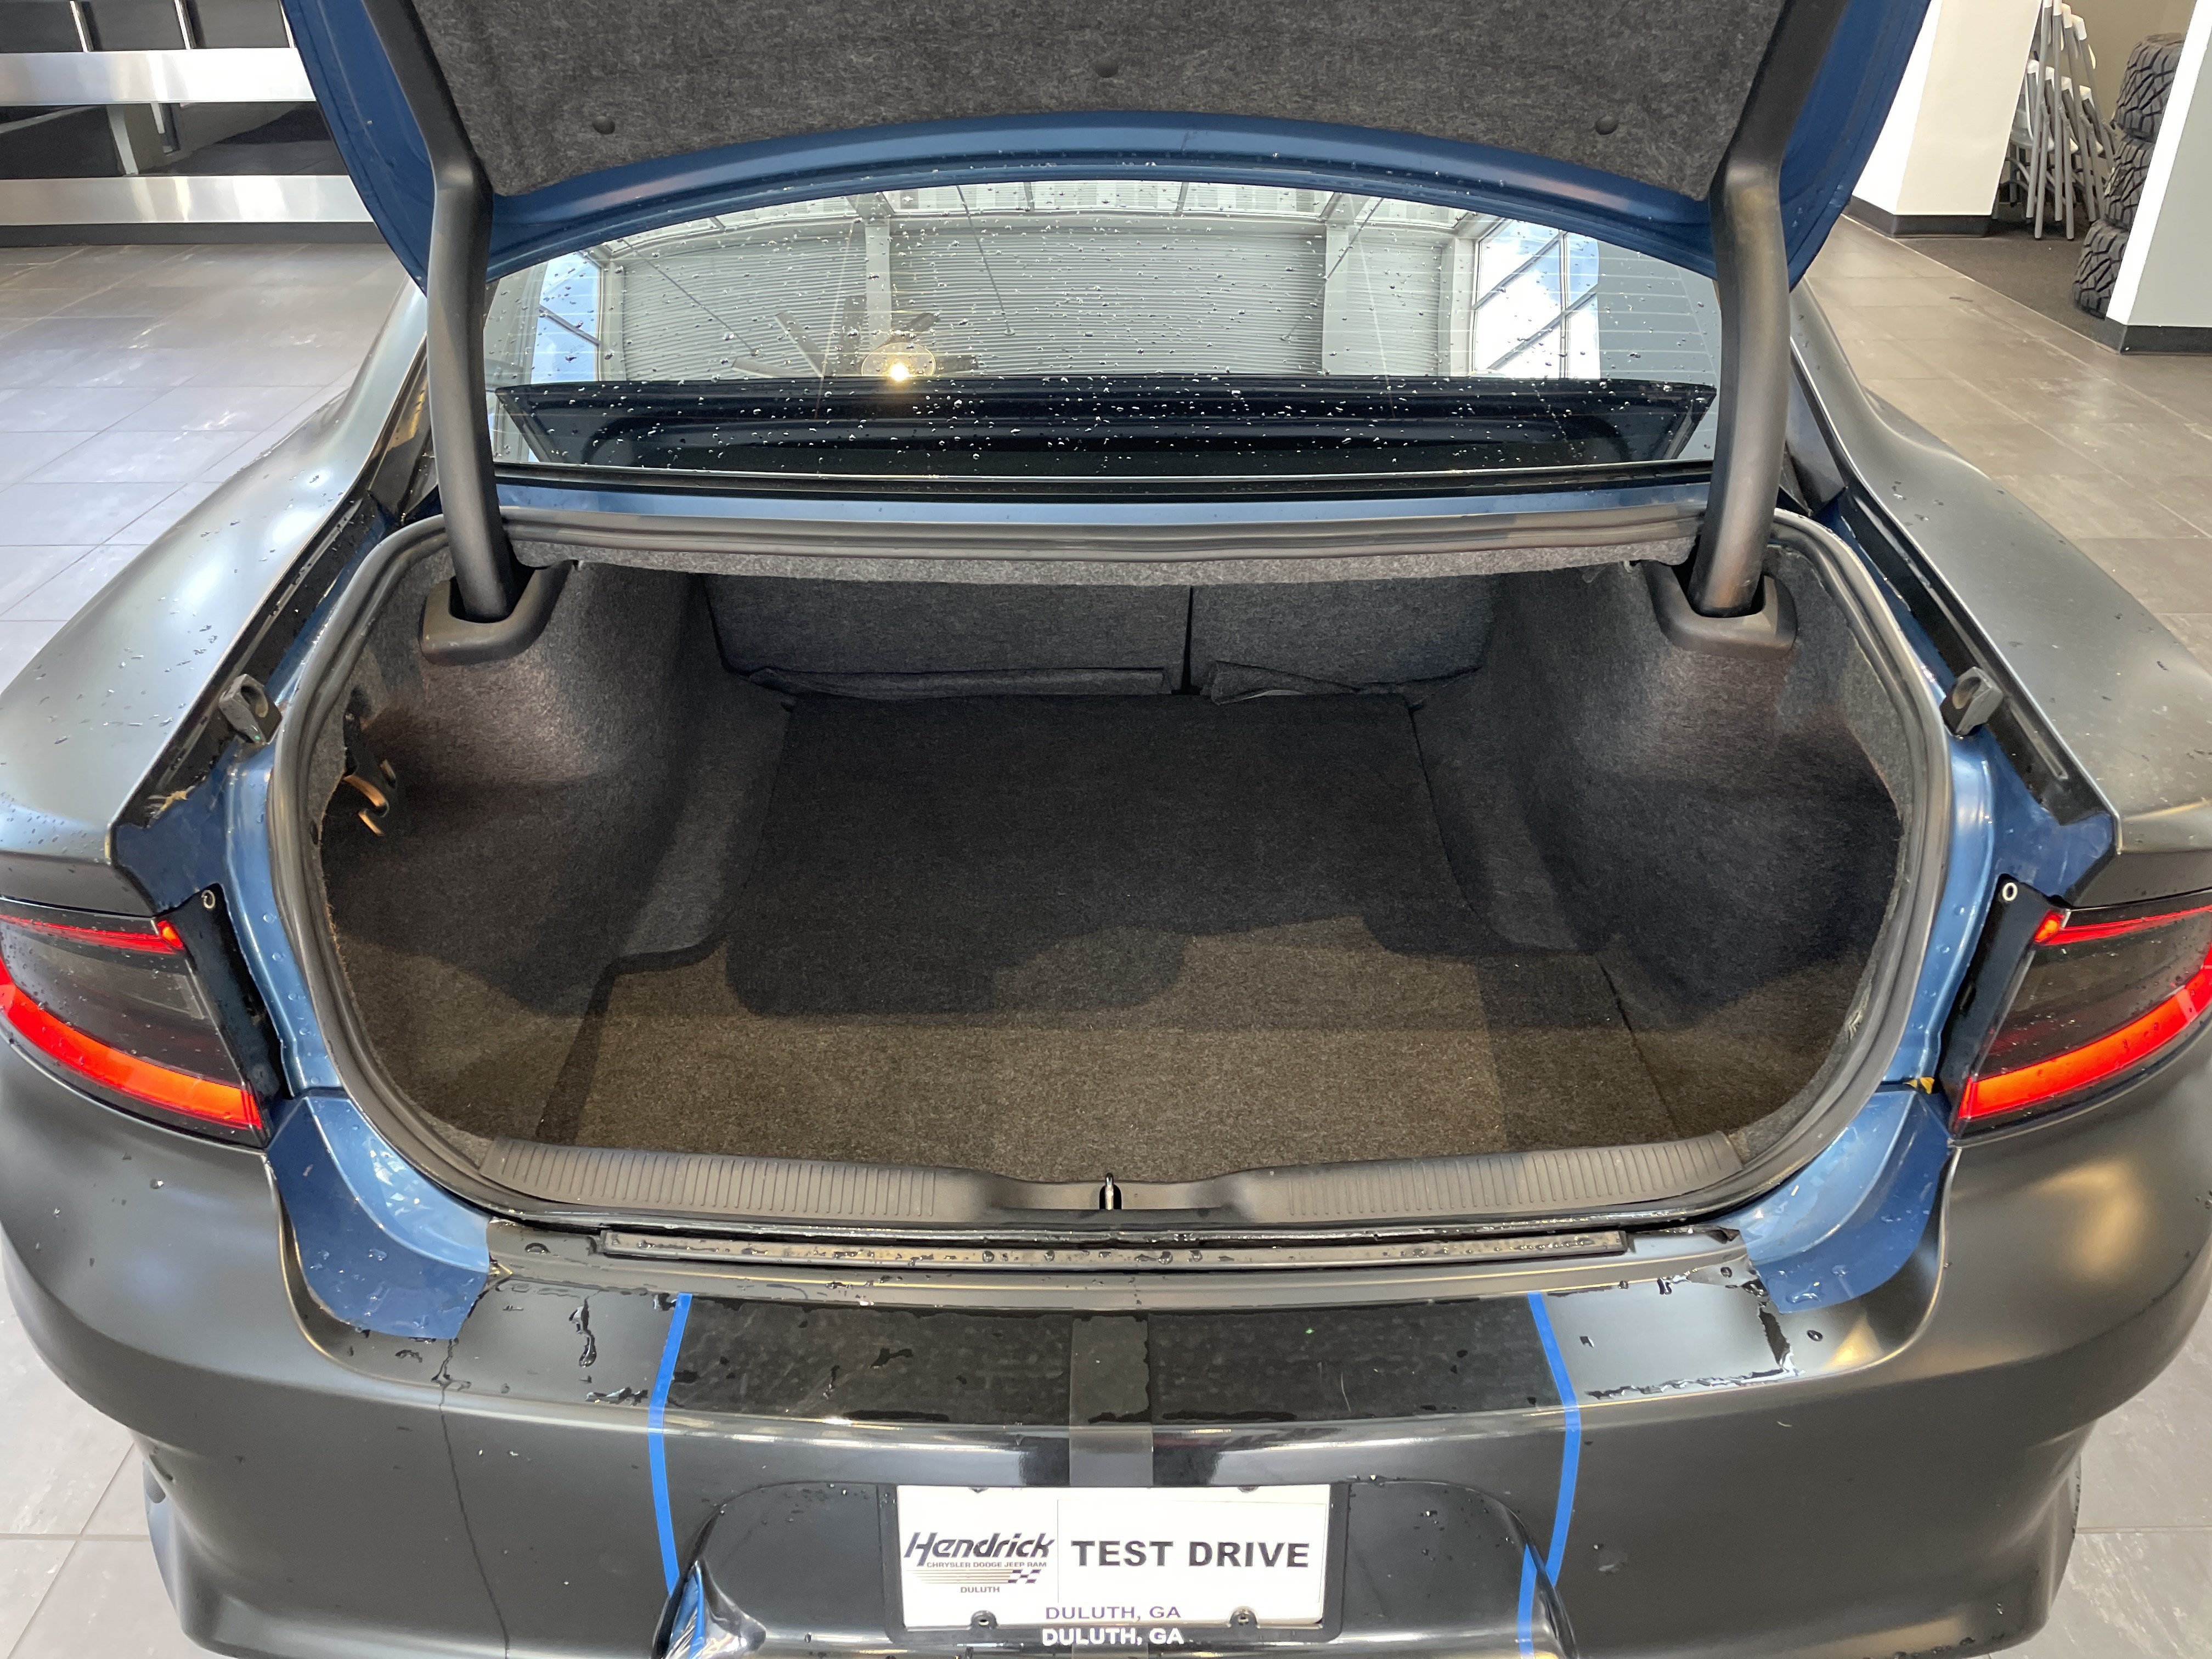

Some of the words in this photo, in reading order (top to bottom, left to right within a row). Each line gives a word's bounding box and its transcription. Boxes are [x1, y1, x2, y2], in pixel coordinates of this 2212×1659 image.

[904, 1532, 1055, 1567] Hendrick
[1071, 1540, 1173, 1567] TEST
[1188, 1541, 1310, 1568] DRIVE
[1046, 1606, 1141, 1623] DULUTH,
[1149, 1606, 1181, 1618] GA
[1042, 1627, 1142, 1646] DULUTH,
[1149, 1627, 1184, 1645] GA
